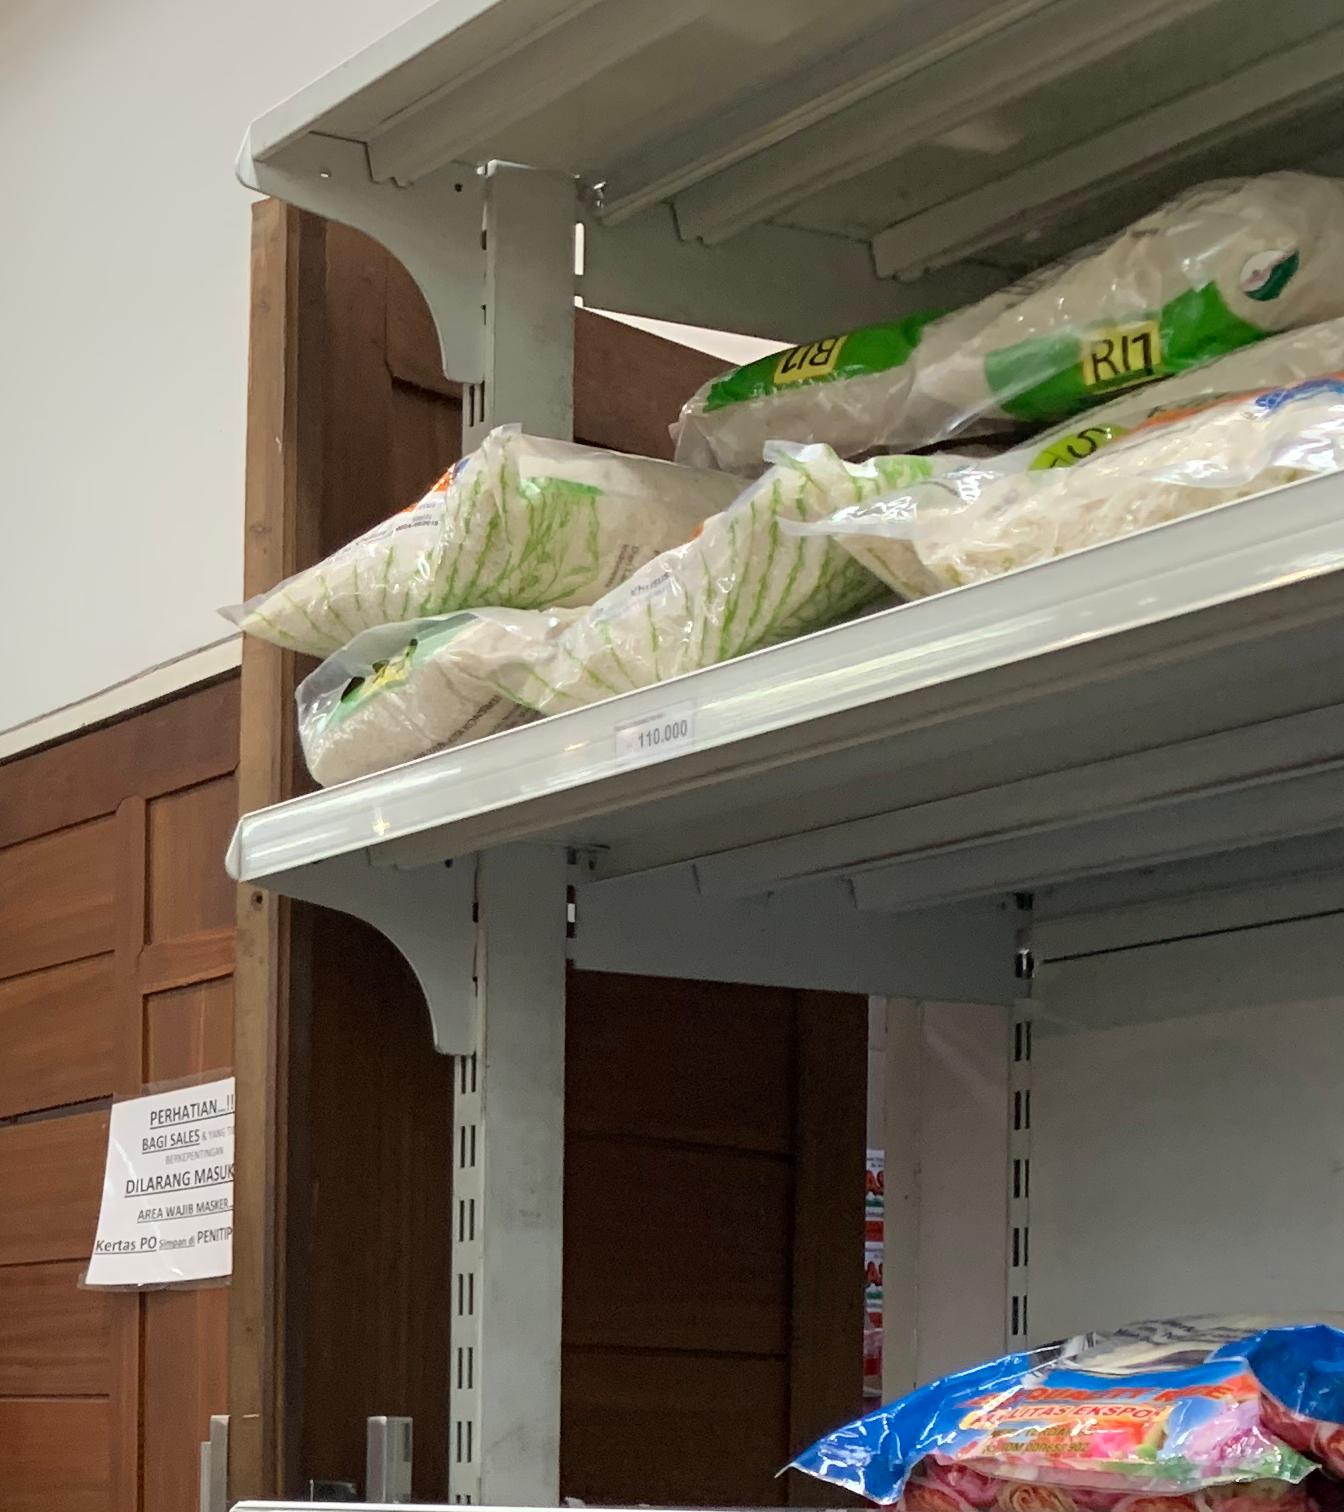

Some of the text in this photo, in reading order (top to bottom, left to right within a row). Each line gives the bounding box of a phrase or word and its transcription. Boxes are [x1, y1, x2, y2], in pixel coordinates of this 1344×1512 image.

[638, 719, 688, 748] 110.000
[142, 1135, 168, 1151] BAGI
[171, 1129, 200, 1148] SALES
[126, 1173, 191, 1194] DILARANG
[137, 1208, 164, 1221] AREA
[166, 1203, 194, 1217] WAJIB
[95, 1239, 136, 1252] Kertas
[140, 1236, 157, 1249] PO
